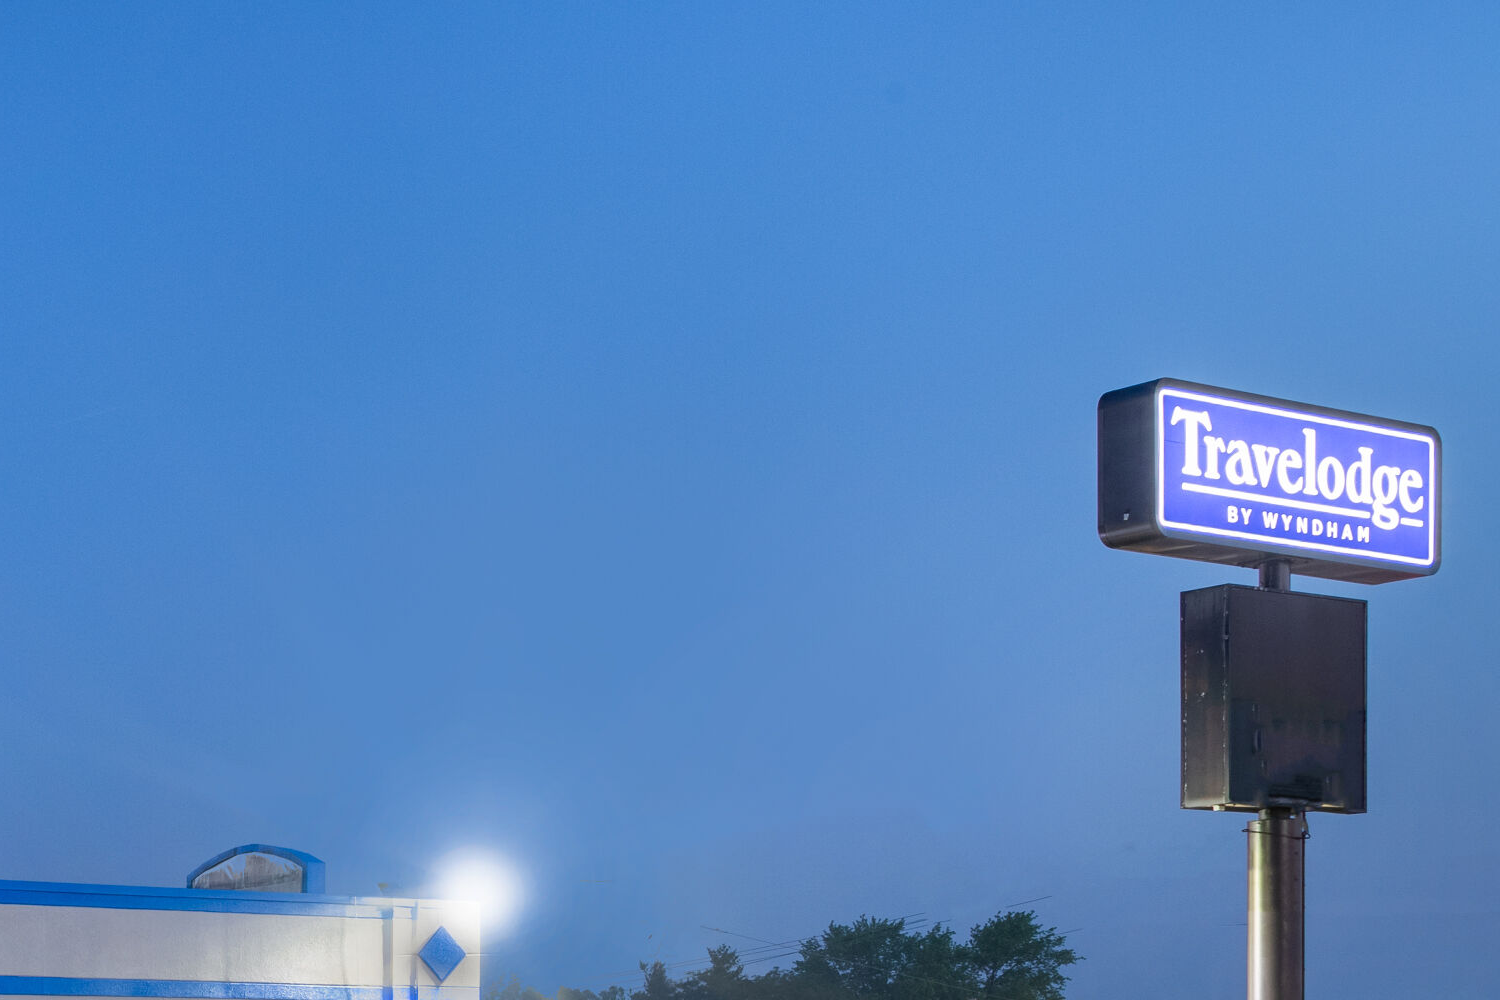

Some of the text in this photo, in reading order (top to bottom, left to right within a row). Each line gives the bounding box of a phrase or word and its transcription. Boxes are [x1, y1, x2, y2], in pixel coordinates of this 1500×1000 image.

[1171, 405, 1424, 530] Travelodge
[1227, 505, 1371, 543] BY WYNDHAM
